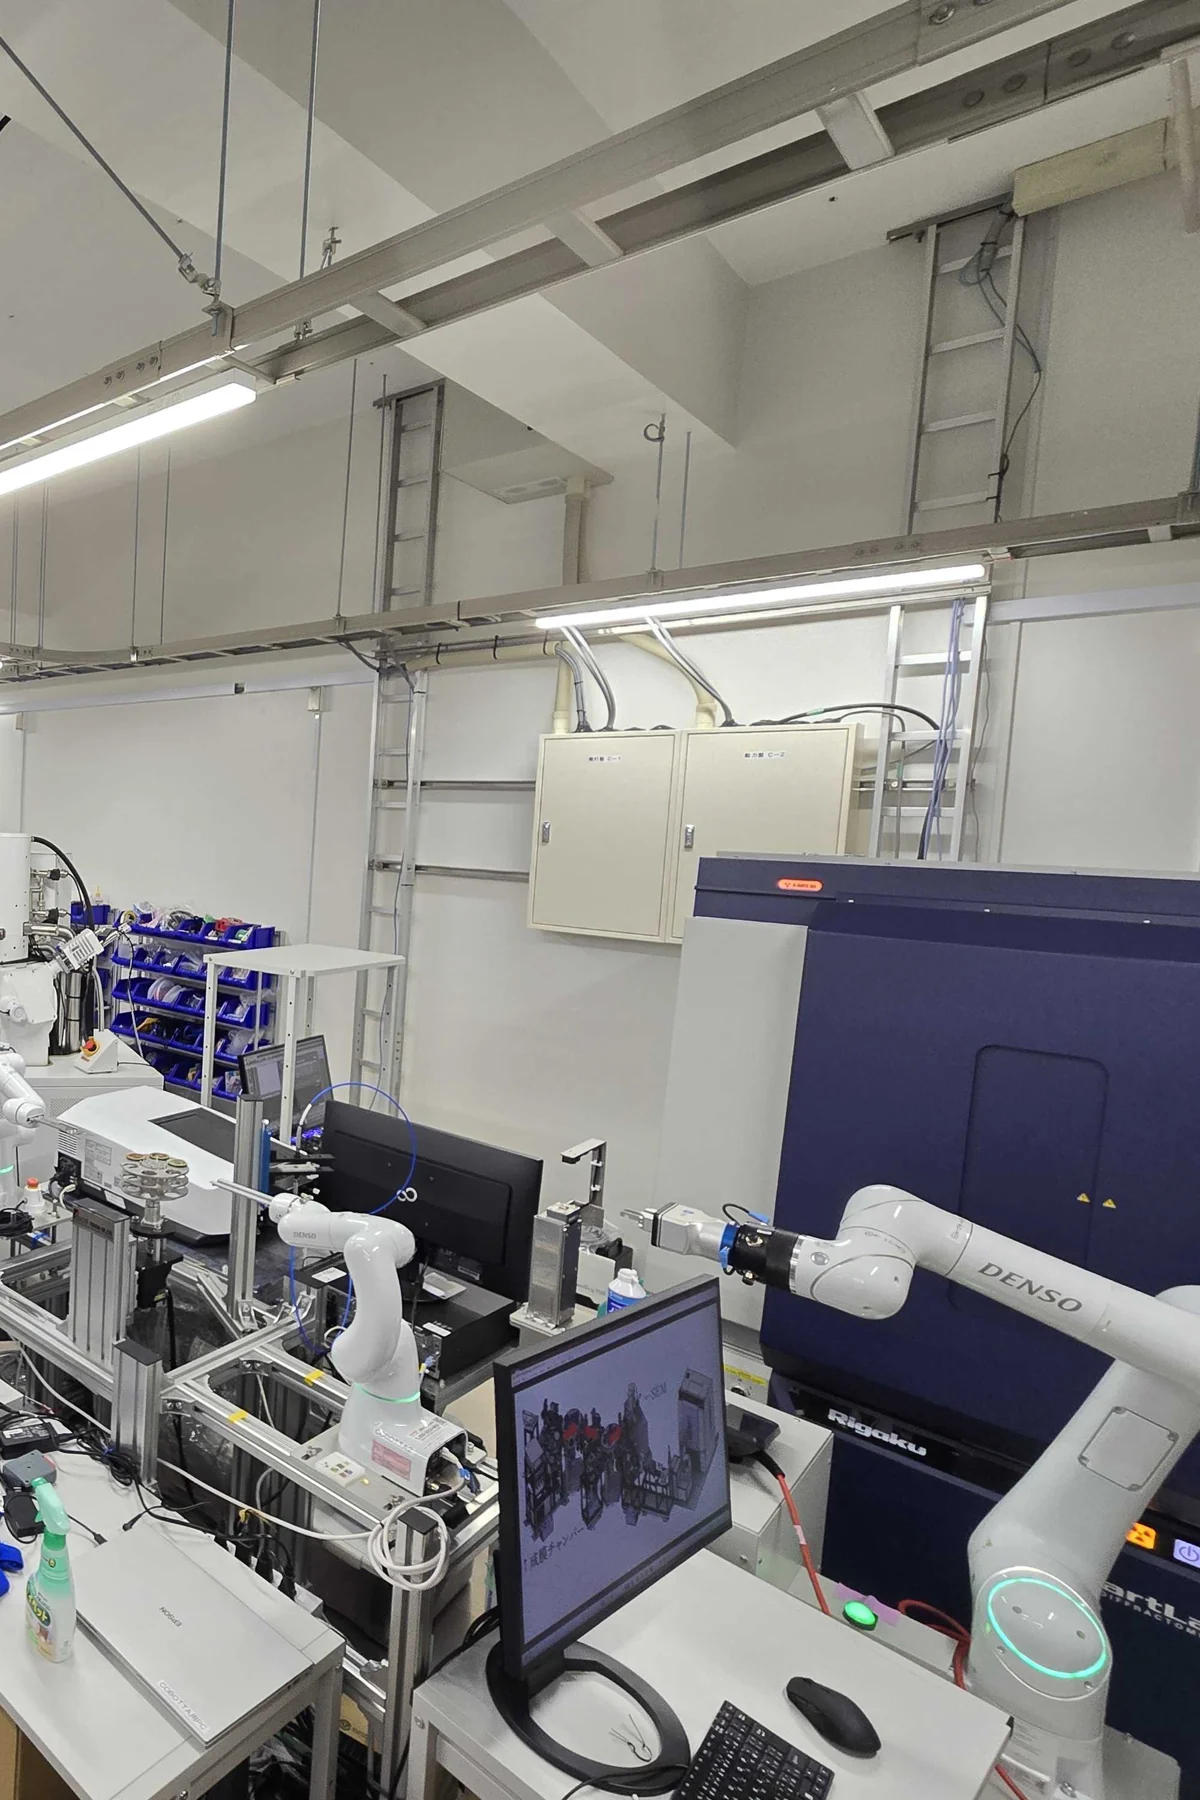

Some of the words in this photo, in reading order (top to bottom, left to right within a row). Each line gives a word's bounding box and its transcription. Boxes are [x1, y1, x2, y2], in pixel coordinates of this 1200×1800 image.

[293, 1231, 317, 1239] DENSO
[978, 1262, 1082, 1312] DENSO
[827, 1408, 927, 1456] Rigaku
[159, 1606, 183, 1627] EPSON
[1100, 1590, 1200, 1640] DIFFRACTOM
